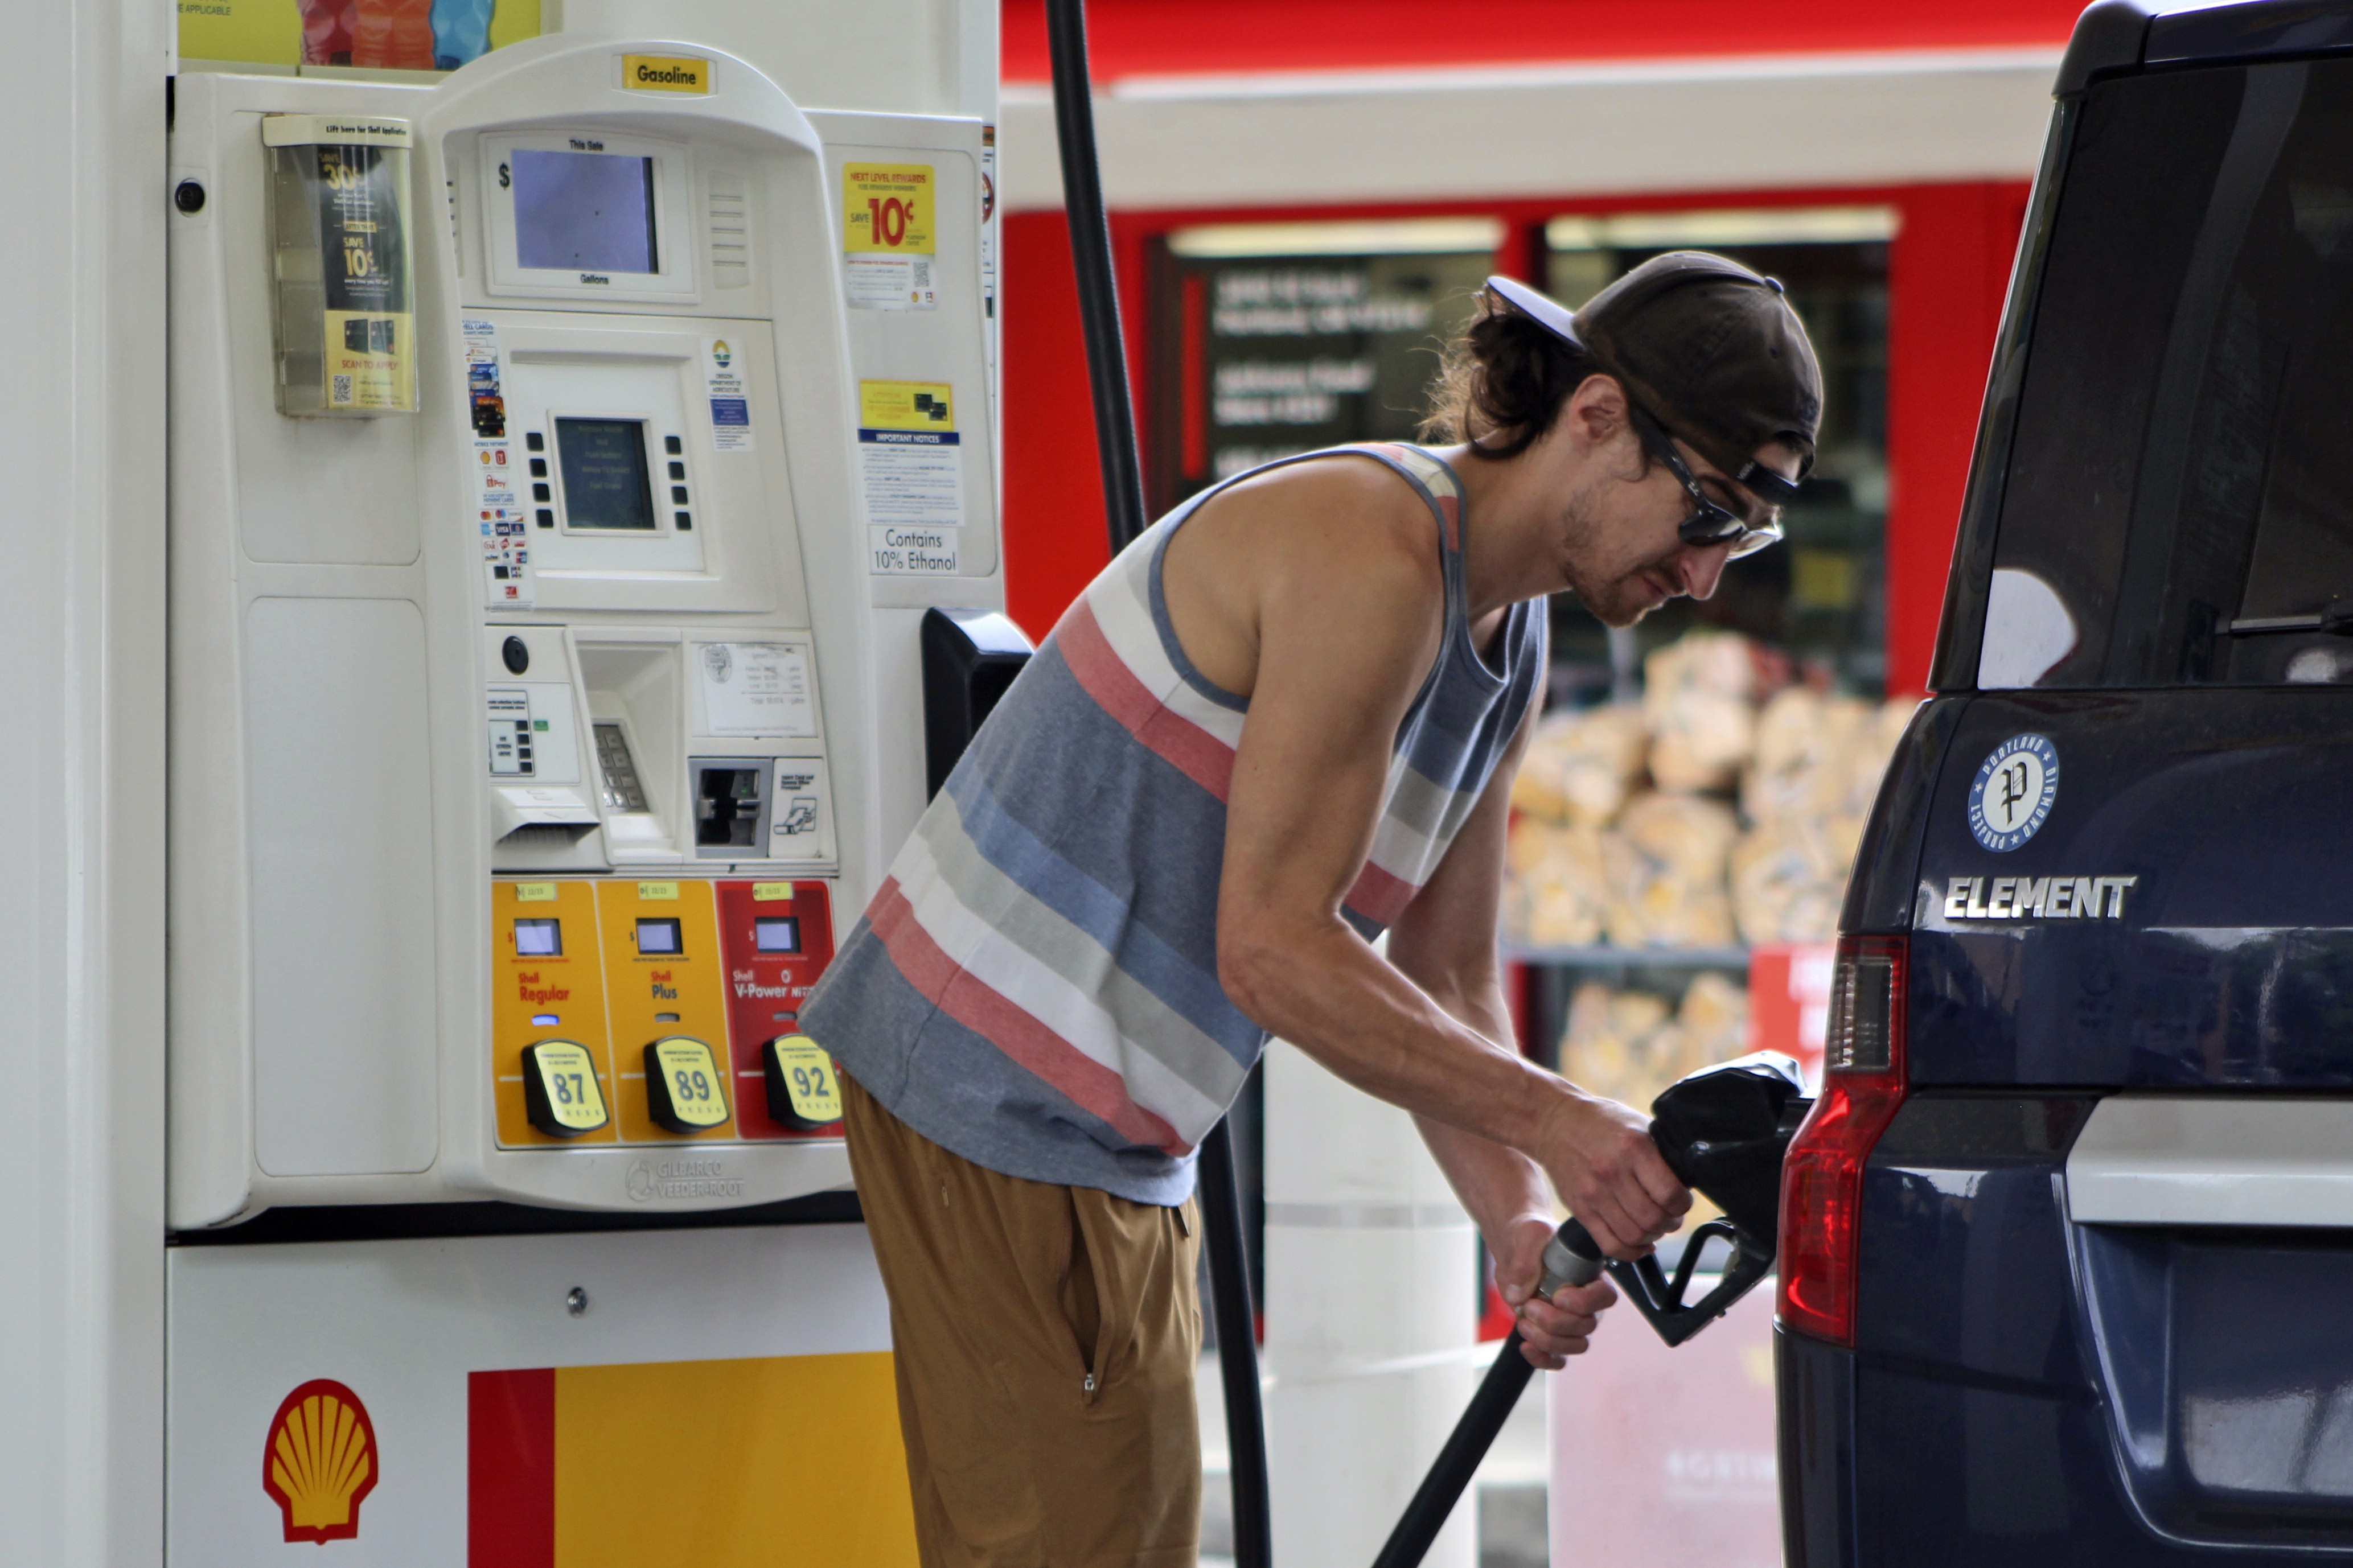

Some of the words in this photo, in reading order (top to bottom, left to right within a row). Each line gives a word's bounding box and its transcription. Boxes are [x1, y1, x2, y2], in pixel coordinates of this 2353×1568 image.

[186, 5, 231, 16] APPLICABLE
[637, 65, 696, 85] Gasoline
[368, 126, 380, 135] Shell
[382, 127, 406, 136] Application
[569, 139, 585, 150] This
[587, 141, 603, 151] Sale
[498, 162, 510, 191] $
[850, 172, 869, 182] NEXT
[870, 173, 890, 183] LEVEL
[892, 174, 926, 183] REWARDS
[850, 213, 869, 223] SAVE
[868, 197, 914, 247] 10¢
[343, 237, 364, 248] SAVE
[580, 274, 609, 285] Gallons
[342, 360, 362, 369] SCAN
[364, 360, 373, 369] TO
[376, 361, 398, 370] APPLY
[876, 434, 912, 443] IMPORTANT
[913, 435, 939, 444] NOTICES
[885, 529, 942, 548] Contains
[875, 550, 903, 569] 10%
[908, 552, 956, 570] Ethanol
[1982, 736, 2043, 775] PORTLAND
[1999, 761, 2027, 826] P
[2022, 767, 2056, 838] DIAMOND
[1970, 804, 2006, 849] PROJECT
[1944, 876, 2138, 919] ELEMENT
[518, 973, 539, 983] Shell
[651, 970, 671, 982] Shell
[733, 970, 753, 982] Shell
[519, 983, 570, 1006] Regular
[652, 983, 677, 999] Plus
[734, 983, 787, 998] V-Power
[553, 1073, 584, 1104] 87
[675, 1070, 709, 1101] 89
[792, 1067, 830, 1097] 92
[656, 1161, 721, 1178] GILBARCO
[657, 1181, 744, 1198] VEEDER-ROOT
